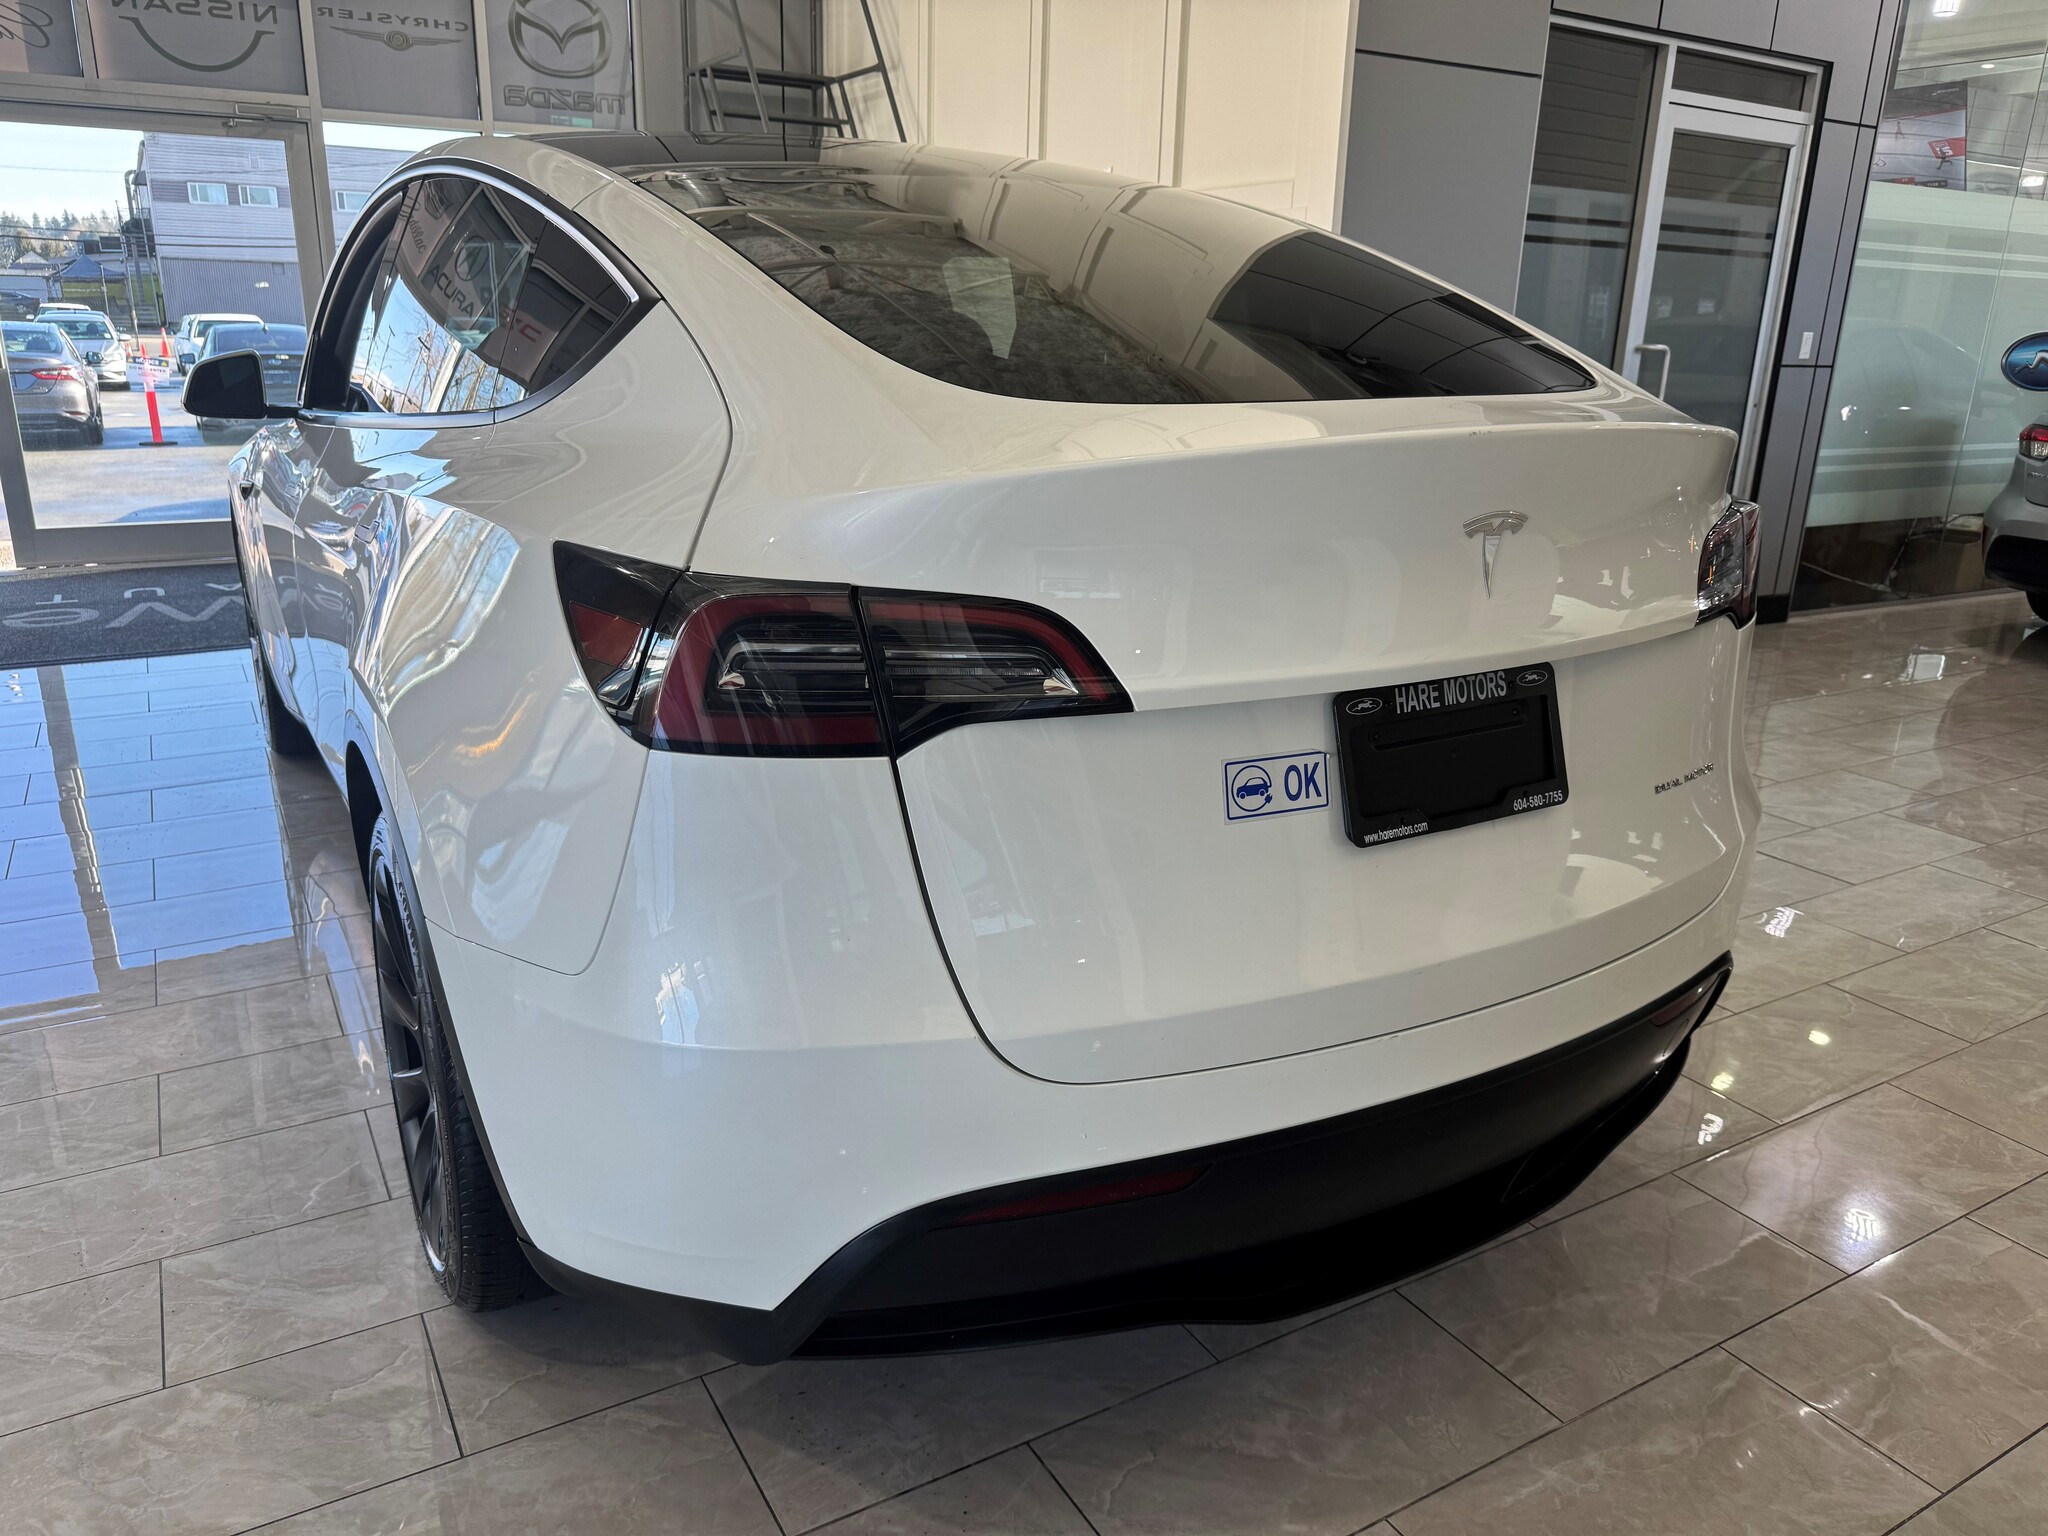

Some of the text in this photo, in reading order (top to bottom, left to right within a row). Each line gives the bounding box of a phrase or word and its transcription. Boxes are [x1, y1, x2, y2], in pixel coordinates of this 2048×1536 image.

[428, 264, 475, 319] ACURA
[1394, 671, 1507, 714] HARE MOTORS
[1284, 761, 1323, 802] OK
[1654, 777, 1683, 795] DUAL
[1513, 790, 1563, 811] 604-580-7755
[1364, 821, 1429, 844] www.haremotors.com
